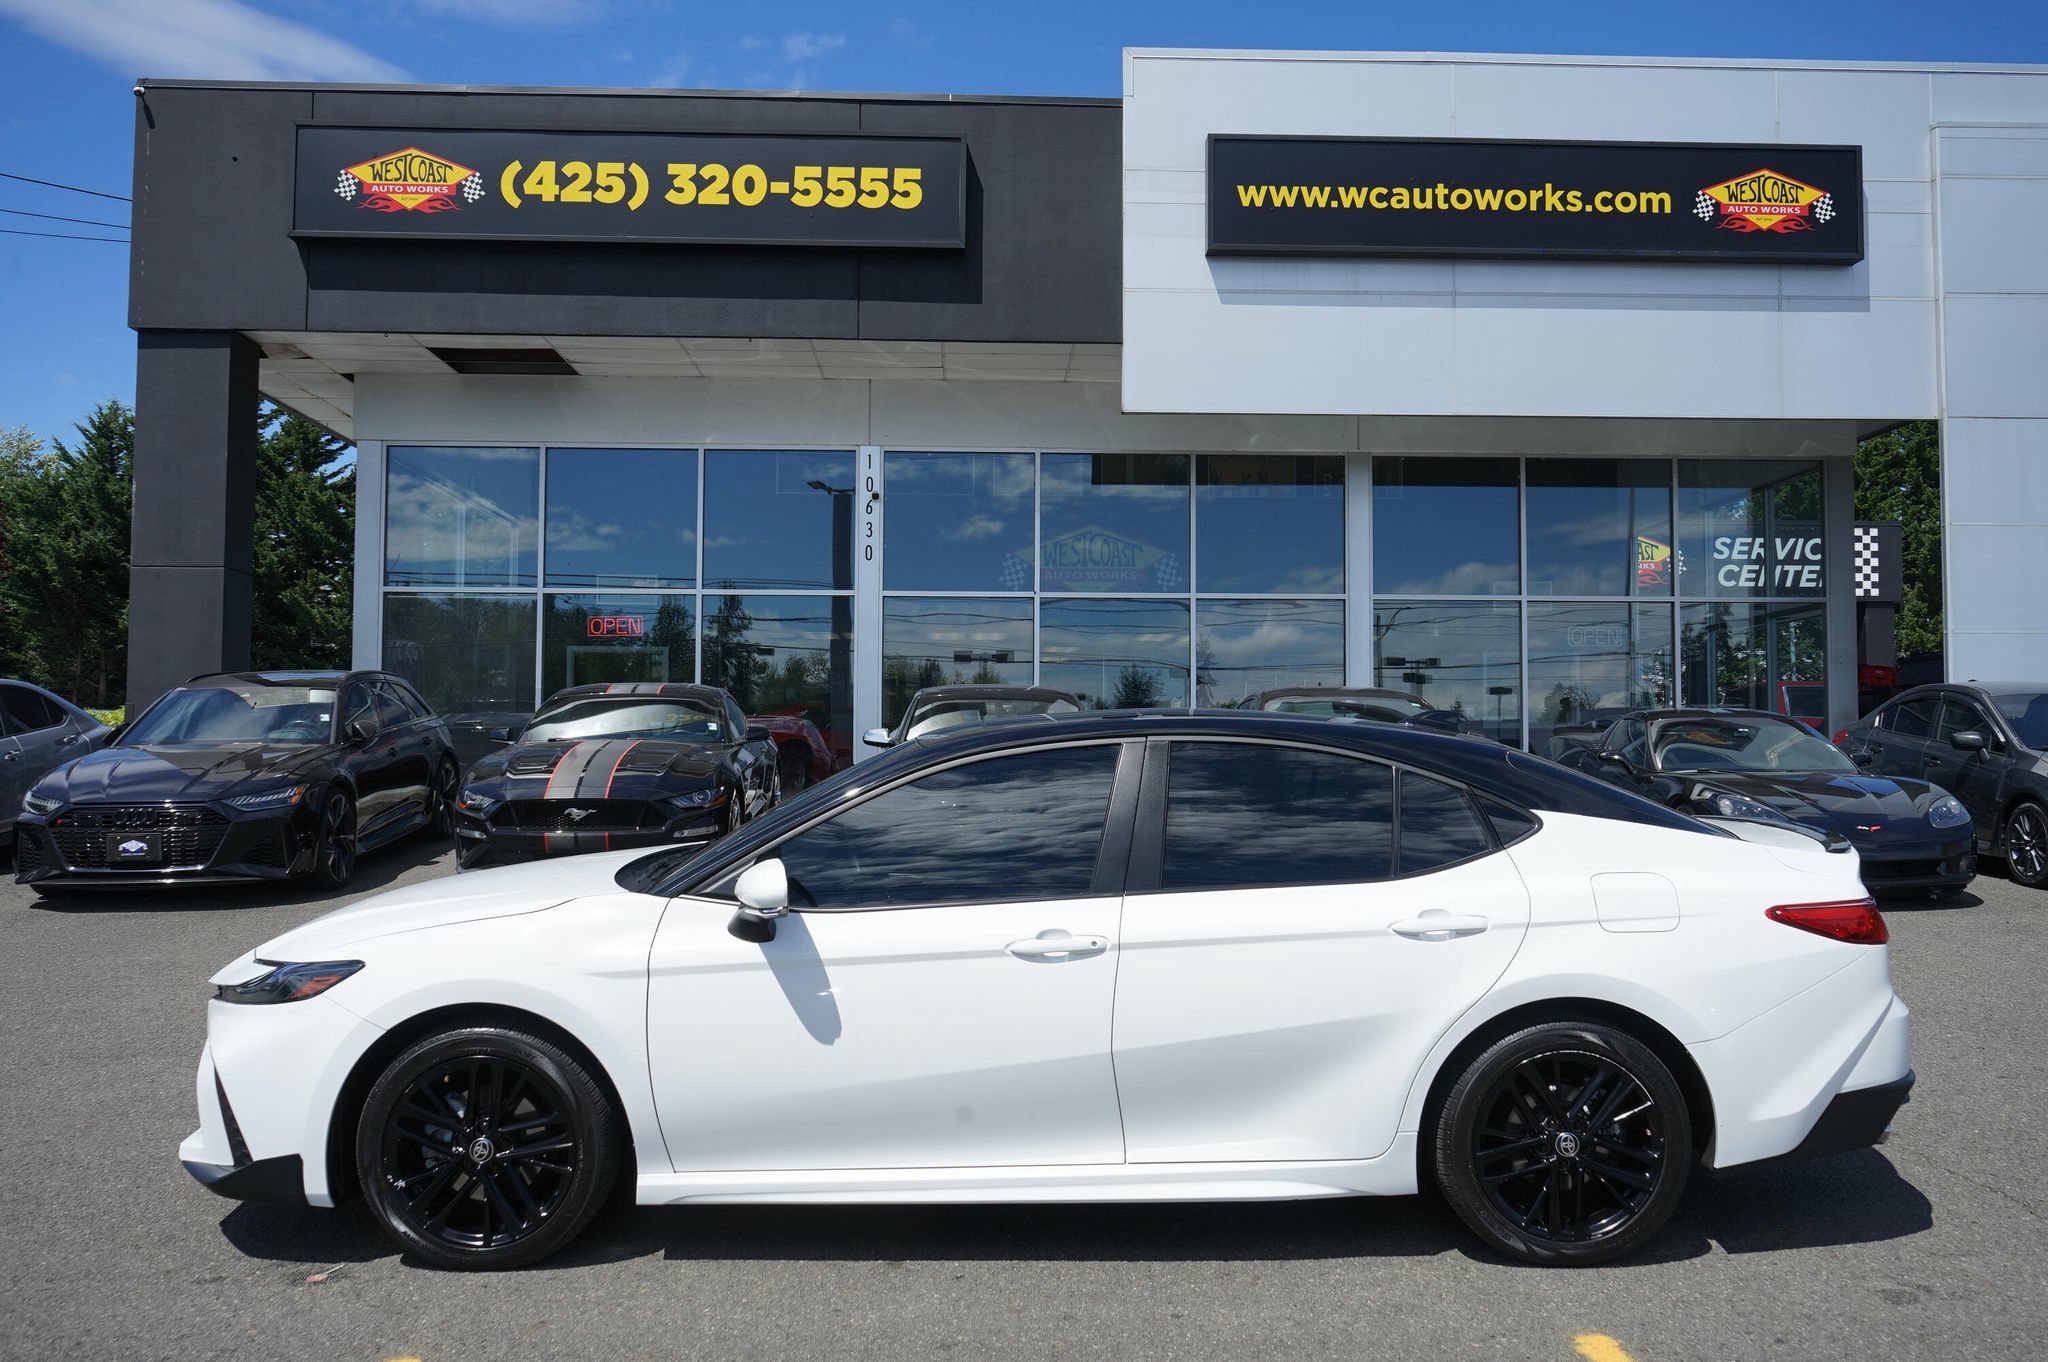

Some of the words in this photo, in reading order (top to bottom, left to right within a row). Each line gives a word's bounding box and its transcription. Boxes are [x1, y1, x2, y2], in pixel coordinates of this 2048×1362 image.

[371, 185, 406, 193] AUTO
[406, 185, 449, 193] WORKS
[501, 160, 649, 211] (425)
[664, 163, 923, 210] 320-5555
[1237, 183, 1671, 214] www.wcautoworks.com
[1728, 205, 1758, 213] AUTO
[1760, 206, 1801, 214] WORKS
[865, 454, 874, 561] 10630
[1713, 537, 1822, 561] SERVIC
[1045, 570, 1083, 580] AUTO
[1087, 570, 1137, 580] WORKS
[590, 617, 641, 634] OPEN
[1571, 628, 1620, 645] OPEN
